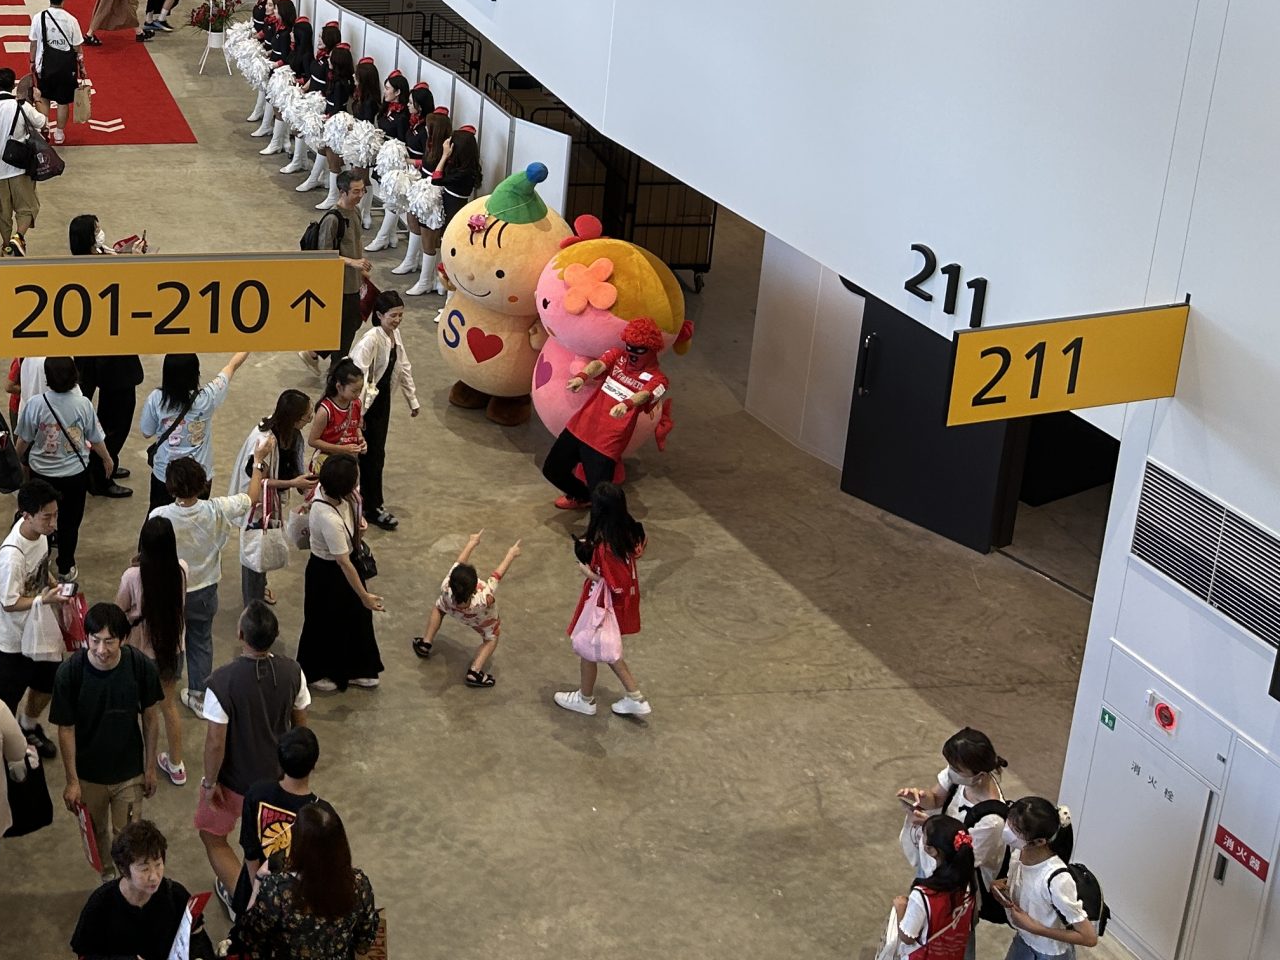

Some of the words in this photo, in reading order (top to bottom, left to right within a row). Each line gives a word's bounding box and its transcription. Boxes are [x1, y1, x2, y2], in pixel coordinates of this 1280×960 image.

[11, 279, 270, 339] 201-210
[904, 243, 990, 328] 211
[971, 337, 1085, 407] 211
[1130, 760, 1176, 803] 消火栓
[1222, 834, 1262, 872] 消火器
